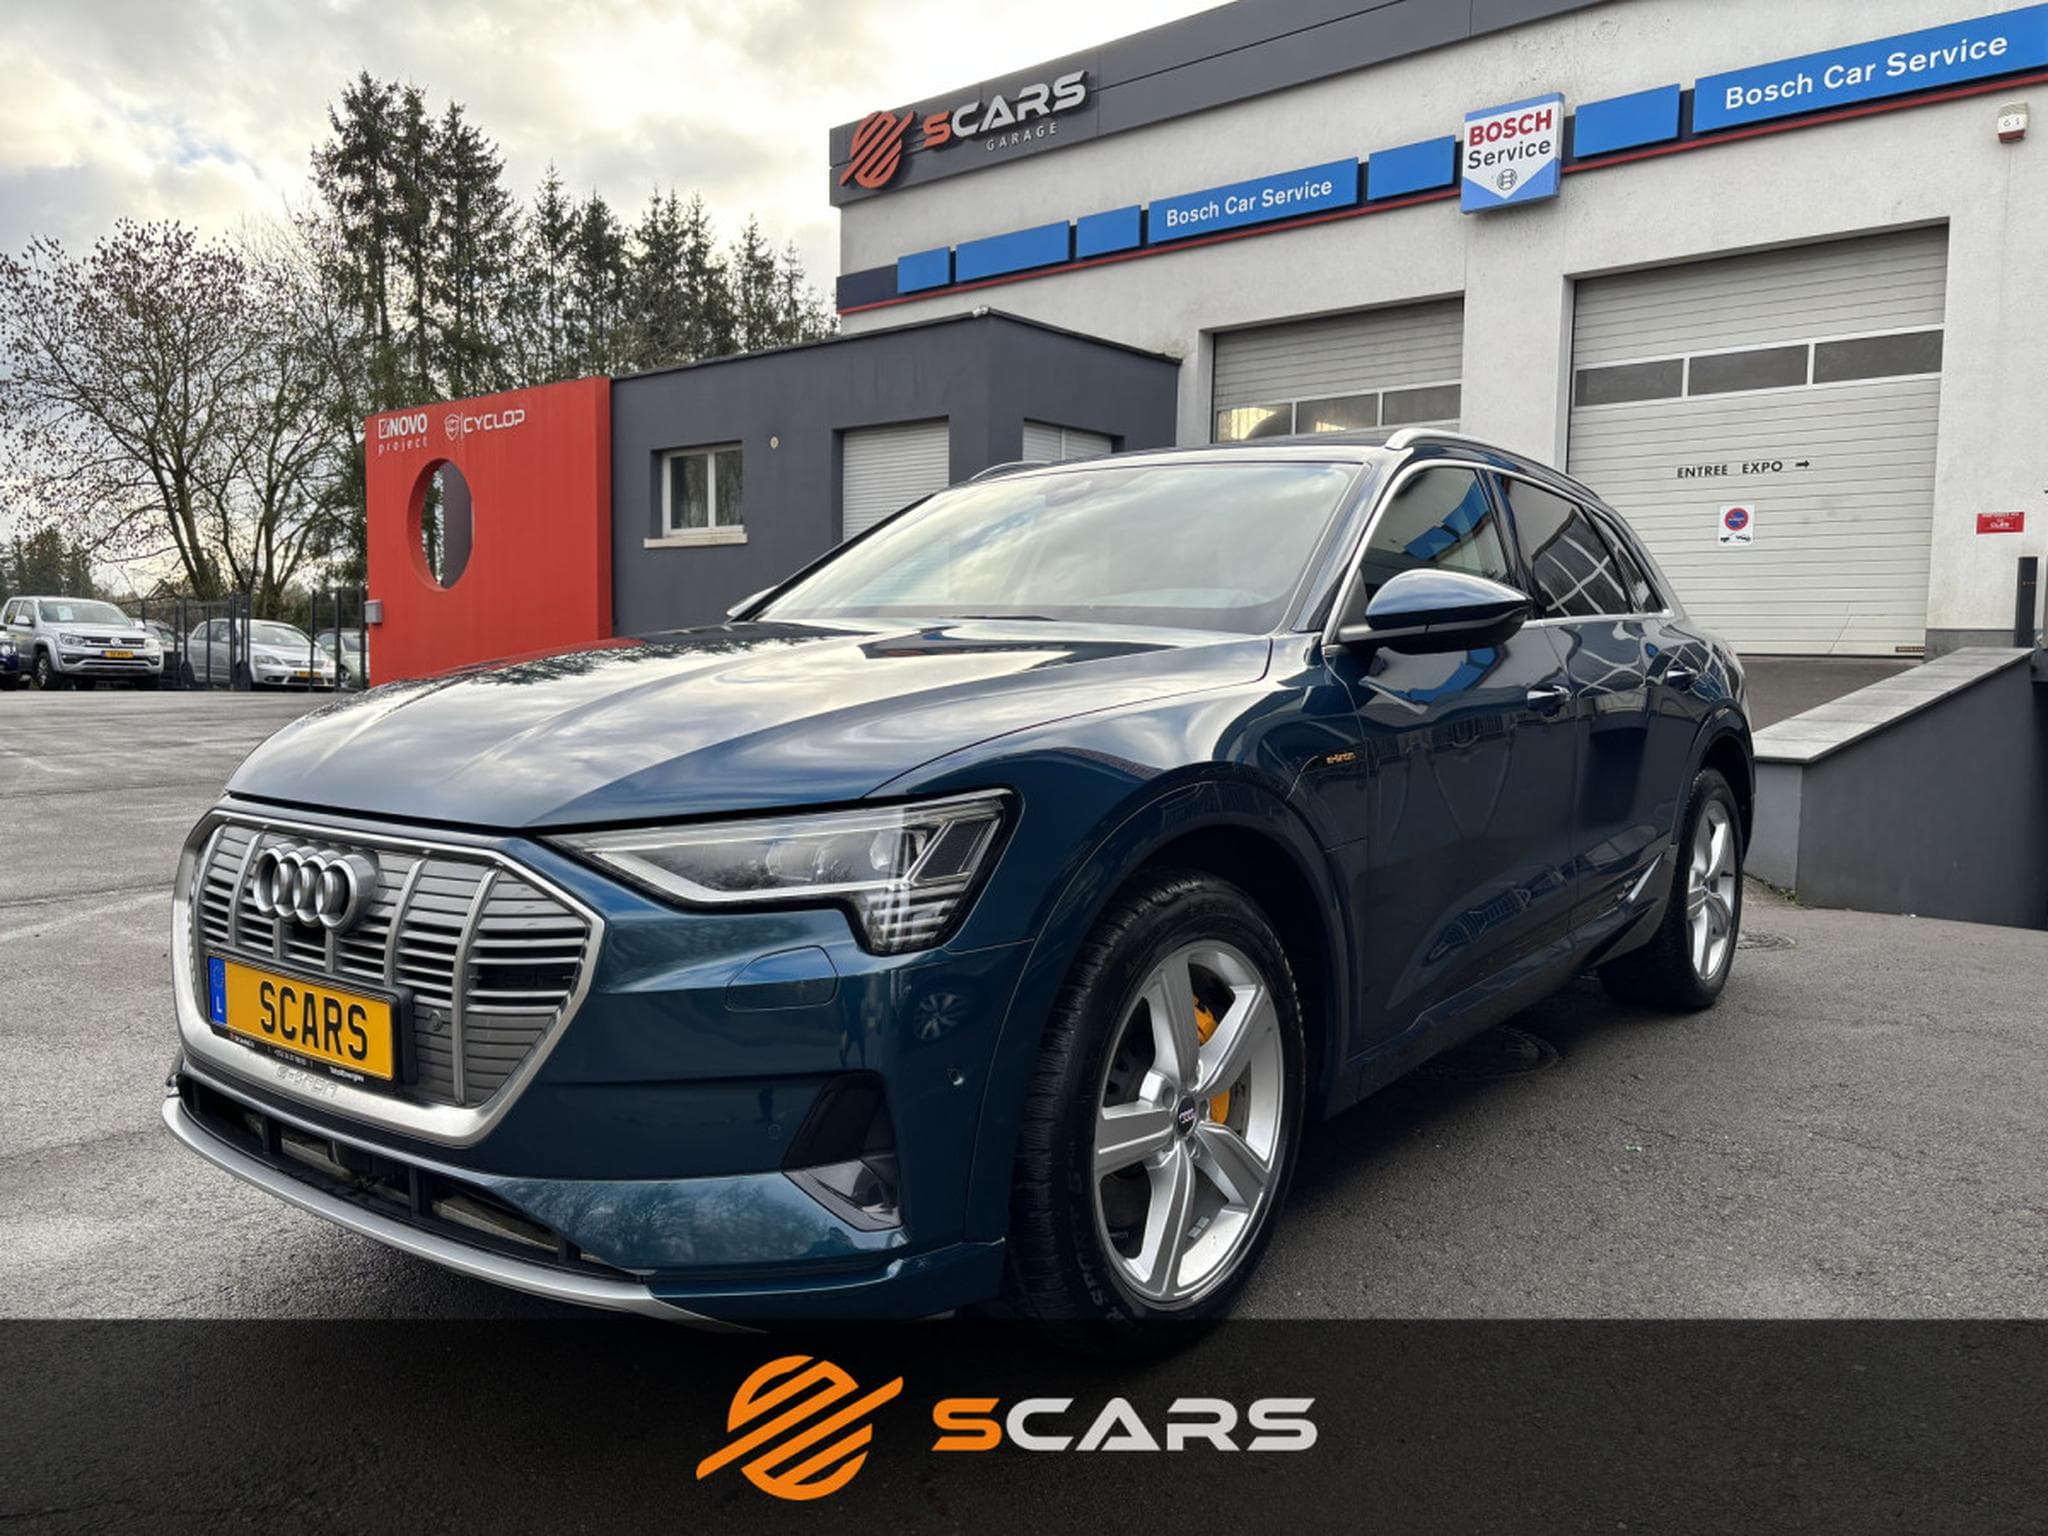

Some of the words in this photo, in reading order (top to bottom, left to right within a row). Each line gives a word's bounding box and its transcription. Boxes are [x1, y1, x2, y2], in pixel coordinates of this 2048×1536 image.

[1725, 73, 1813, 110] Bosch
[1824, 63, 1876, 89] Car
[1886, 36, 2008, 77] Service
[922, 69, 1088, 149] SCARS
[1469, 108, 1552, 147] BOSCH
[986, 121, 1058, 152] GARAGE
[1467, 139, 1551, 170] Service
[1166, 202, 1219, 227] Bosch
[1224, 196, 1256, 214] Car
[1261, 180, 1332, 208] Service
[1677, 464, 1728, 478] ENTREE
[1742, 460, 1783, 475] EXPO
[259, 980, 368, 1061] SCARS
